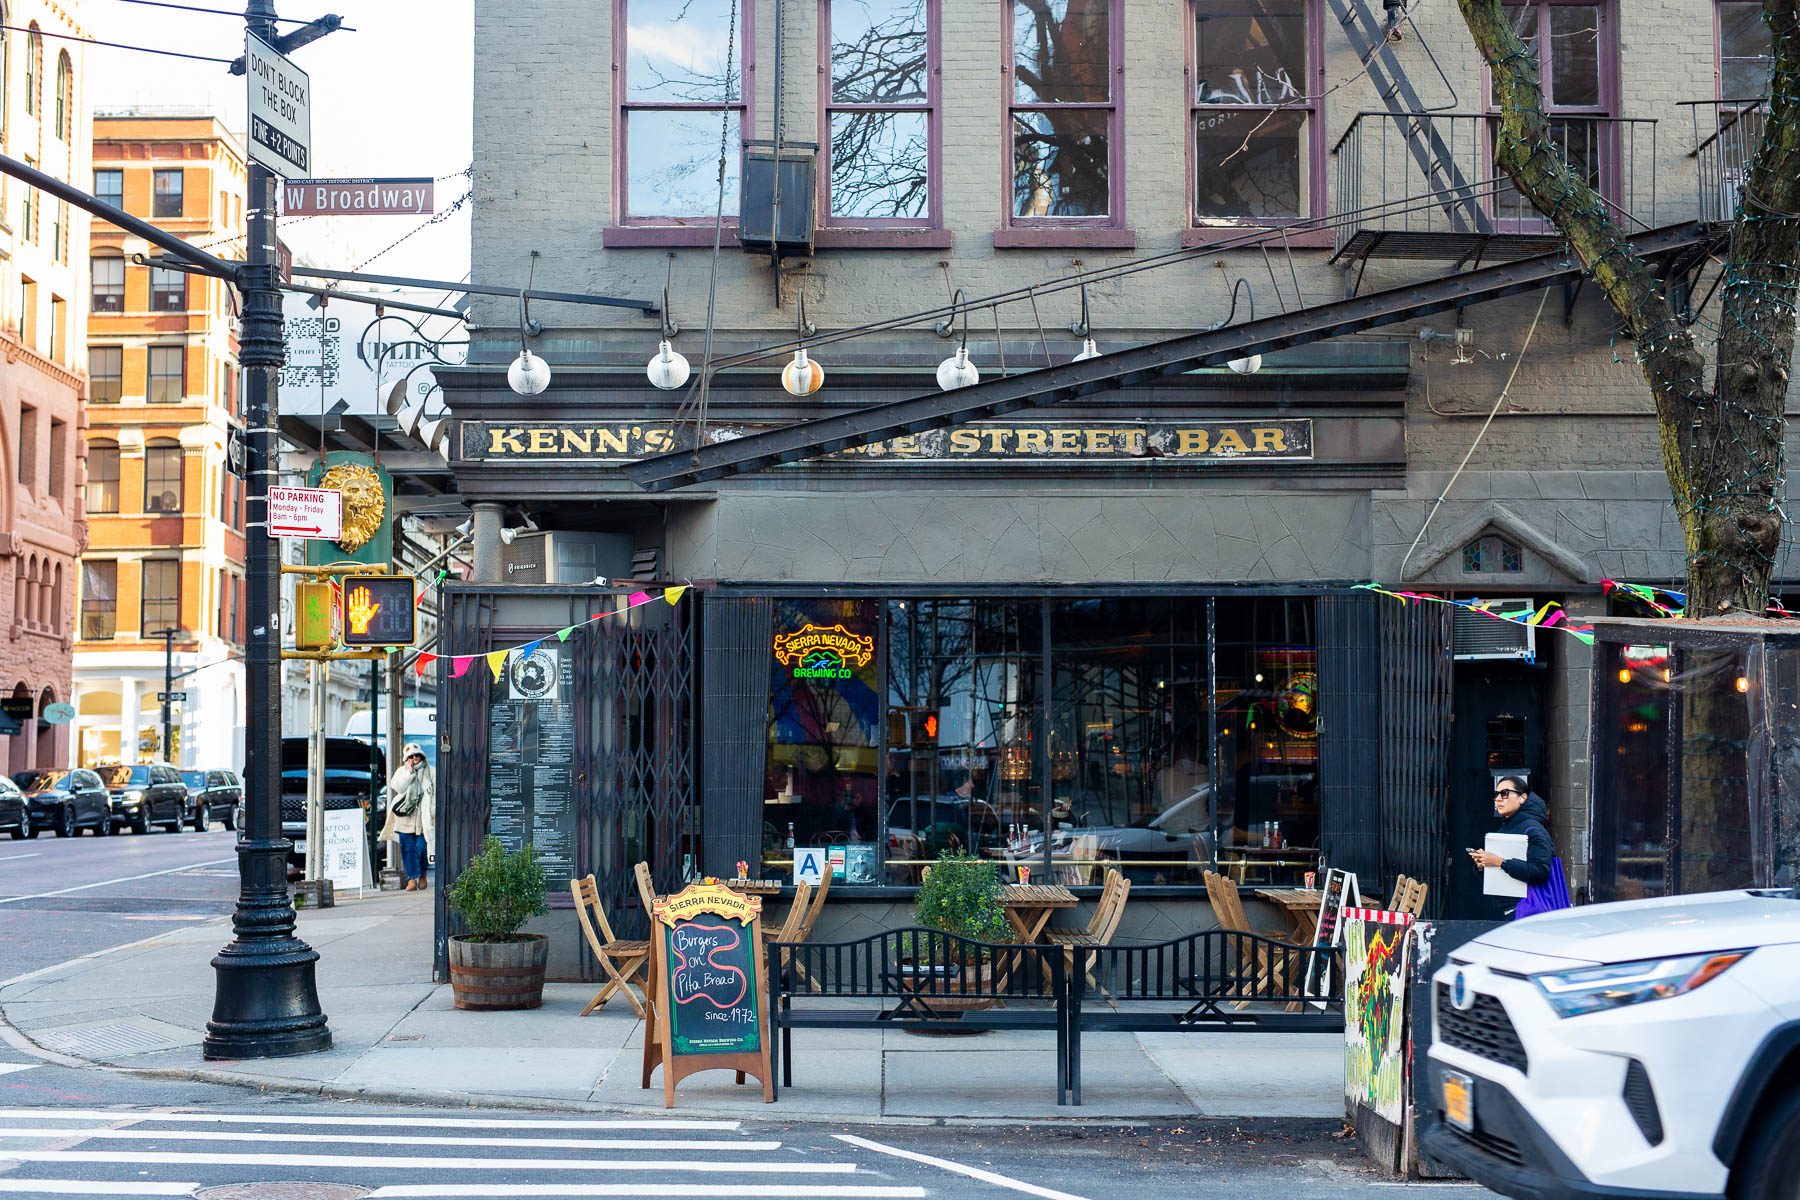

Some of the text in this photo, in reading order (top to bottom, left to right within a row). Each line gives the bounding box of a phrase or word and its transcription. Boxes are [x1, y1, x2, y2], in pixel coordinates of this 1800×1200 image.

[252, 53, 305, 106] DON'T BLOCK
[262, 86, 296, 125] THE BOX
[253, 118, 305, 167] FINE +2 POINTS
[287, 184, 426, 214] W Broadway
[385, 361, 415, 369] TATTOO
[488, 426, 675, 453] KENN'S
[950, 428, 1147, 454] STREET
[1175, 428, 1287, 454] BAR
[273, 491, 325, 503] NO PARKING
[273, 503, 298, 513] Monday
[304, 504, 324, 515] Friday
[273, 512, 288, 520] 8am
[293, 513, 308, 523] 6pm
[785, 634, 862, 655] SIERRA NEVADA
[793, 667, 852, 679] BREWING CO
[324, 824, 350, 832] ATTOO
[800, 853, 819, 875] A
[669, 896, 746, 913] SIERRA NEVADA
[677, 930, 719, 956] Burgers
[688, 955, 706, 968] on
[678, 970, 735, 998] Pita Bread
